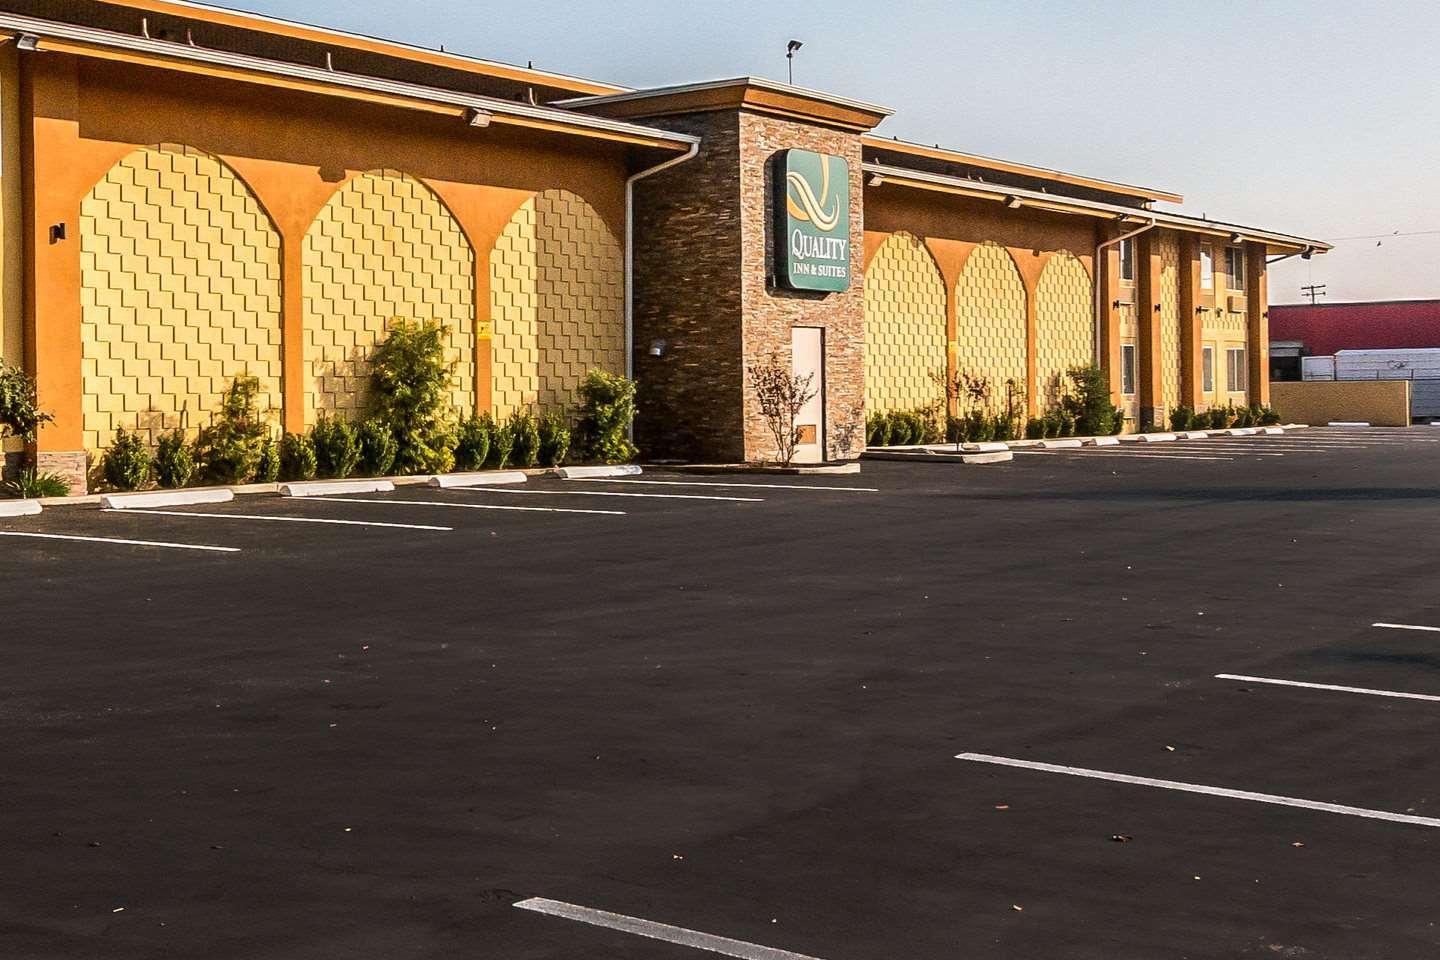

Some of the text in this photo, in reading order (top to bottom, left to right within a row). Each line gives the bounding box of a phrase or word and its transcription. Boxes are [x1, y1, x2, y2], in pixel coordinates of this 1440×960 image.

[792, 228, 846, 261] QUALITY
[793, 263, 846, 278] INN & SUITES
